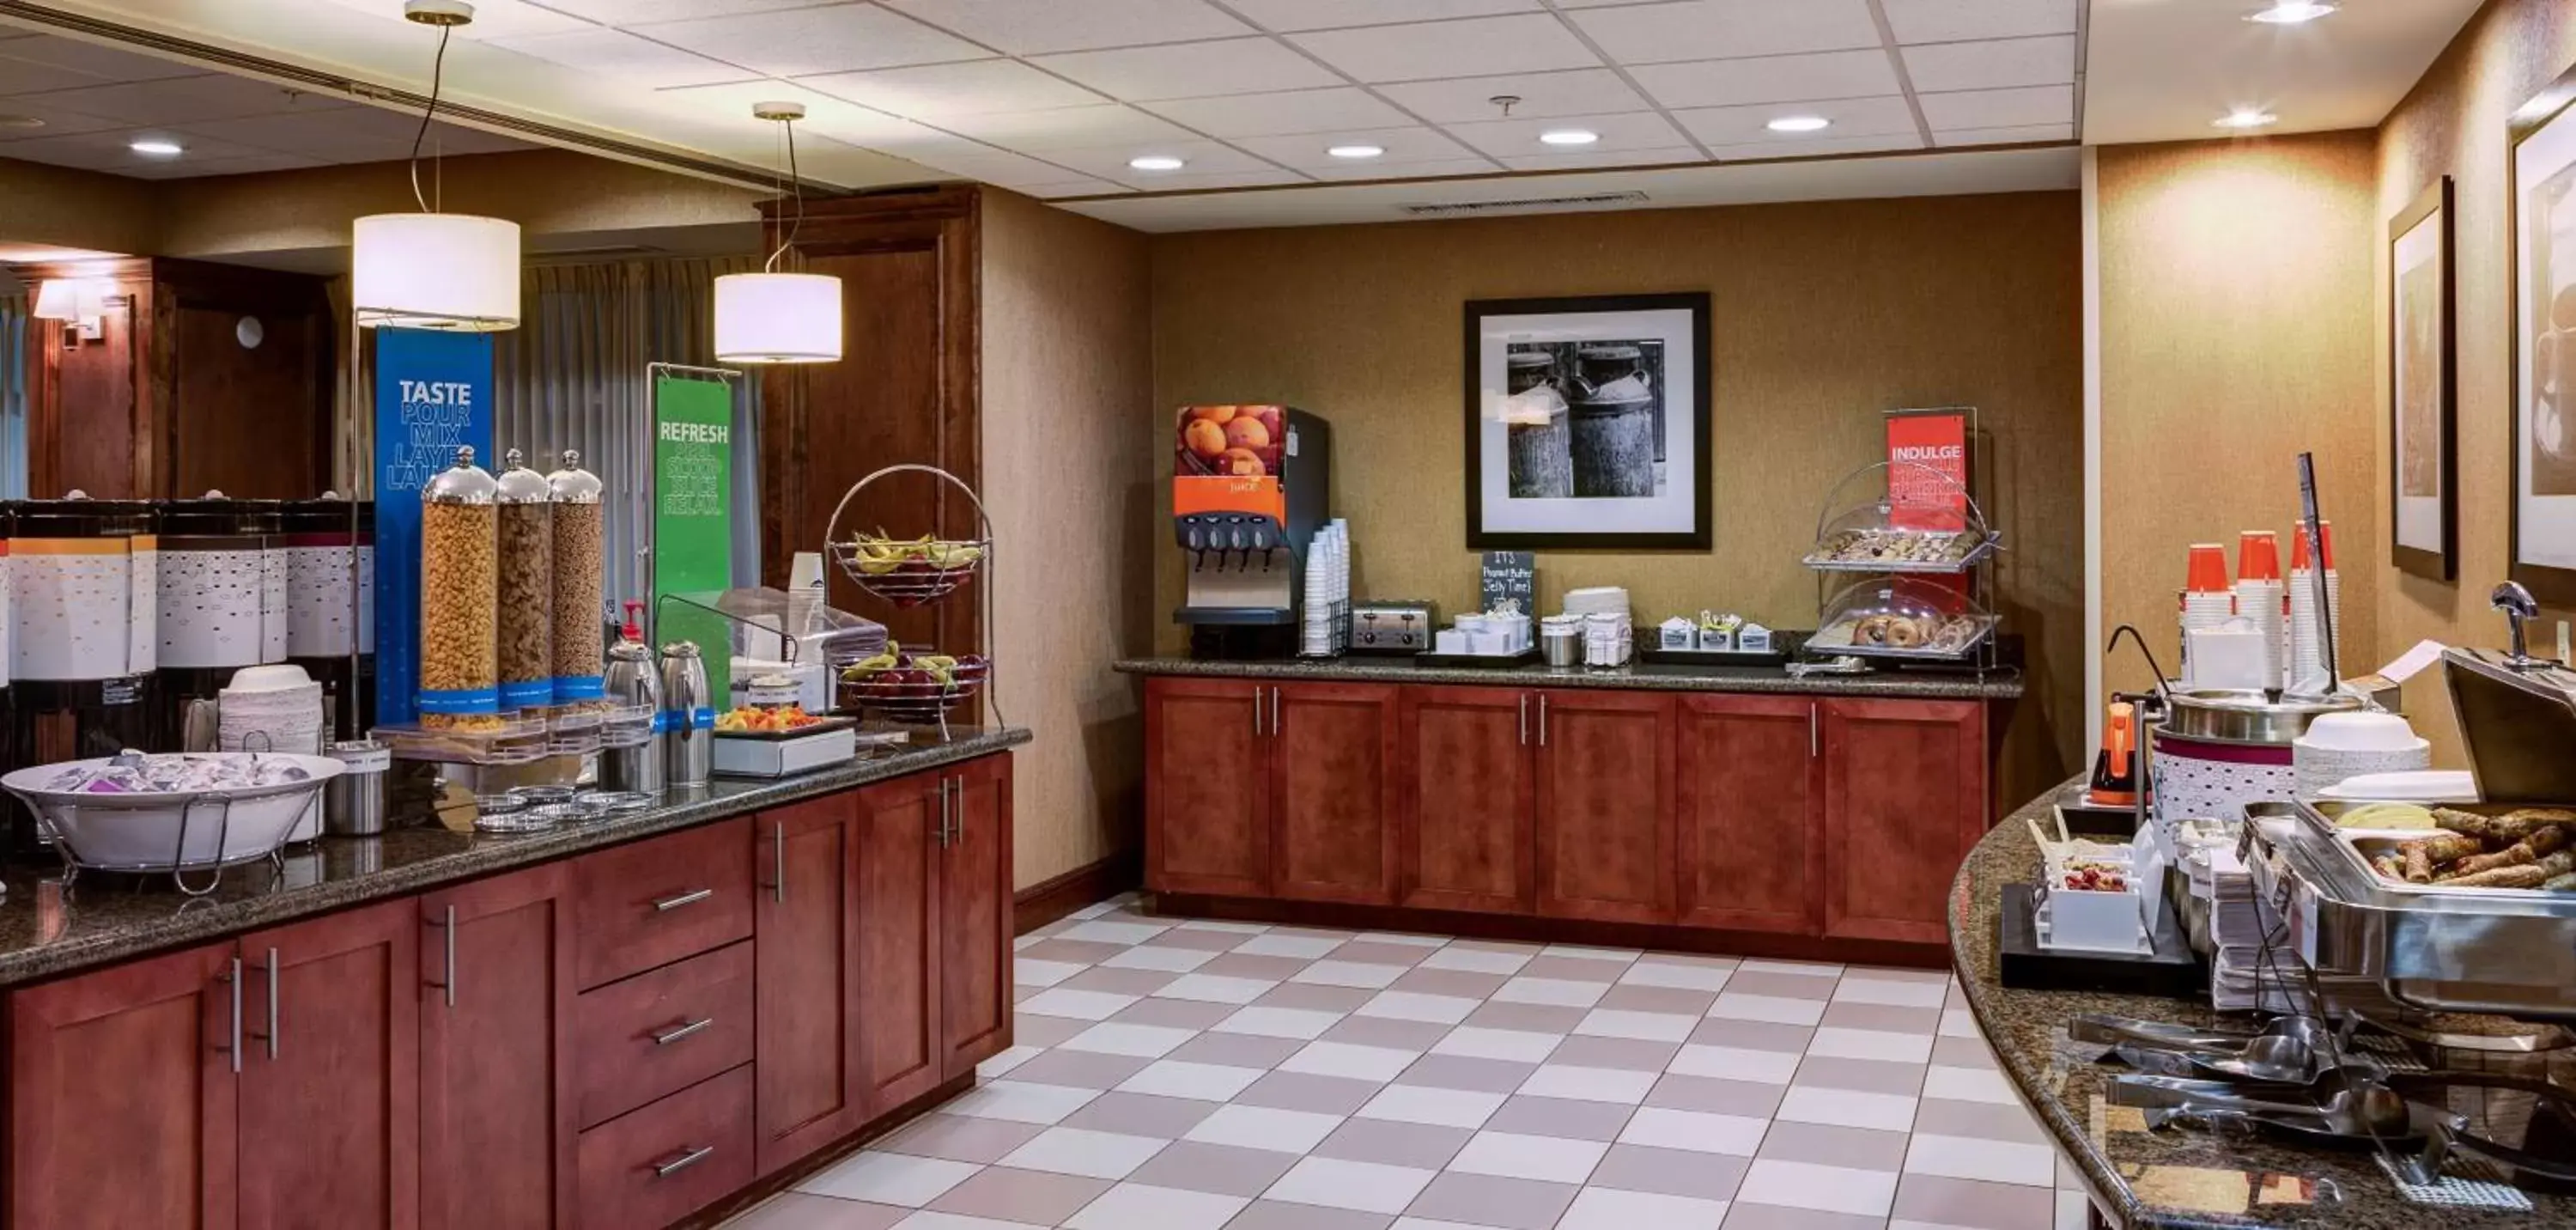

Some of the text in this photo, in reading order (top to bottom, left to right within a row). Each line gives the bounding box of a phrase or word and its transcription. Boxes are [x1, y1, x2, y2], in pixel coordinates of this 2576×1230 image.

[399, 380, 471, 405] TASTE
[401, 401, 471, 427] POUR
[410, 422, 461, 448] MIX
[660, 422, 728, 443] REFRESH
[395, 442, 475, 468] LAYE
[1892, 445, 1962, 461] INDULGE
